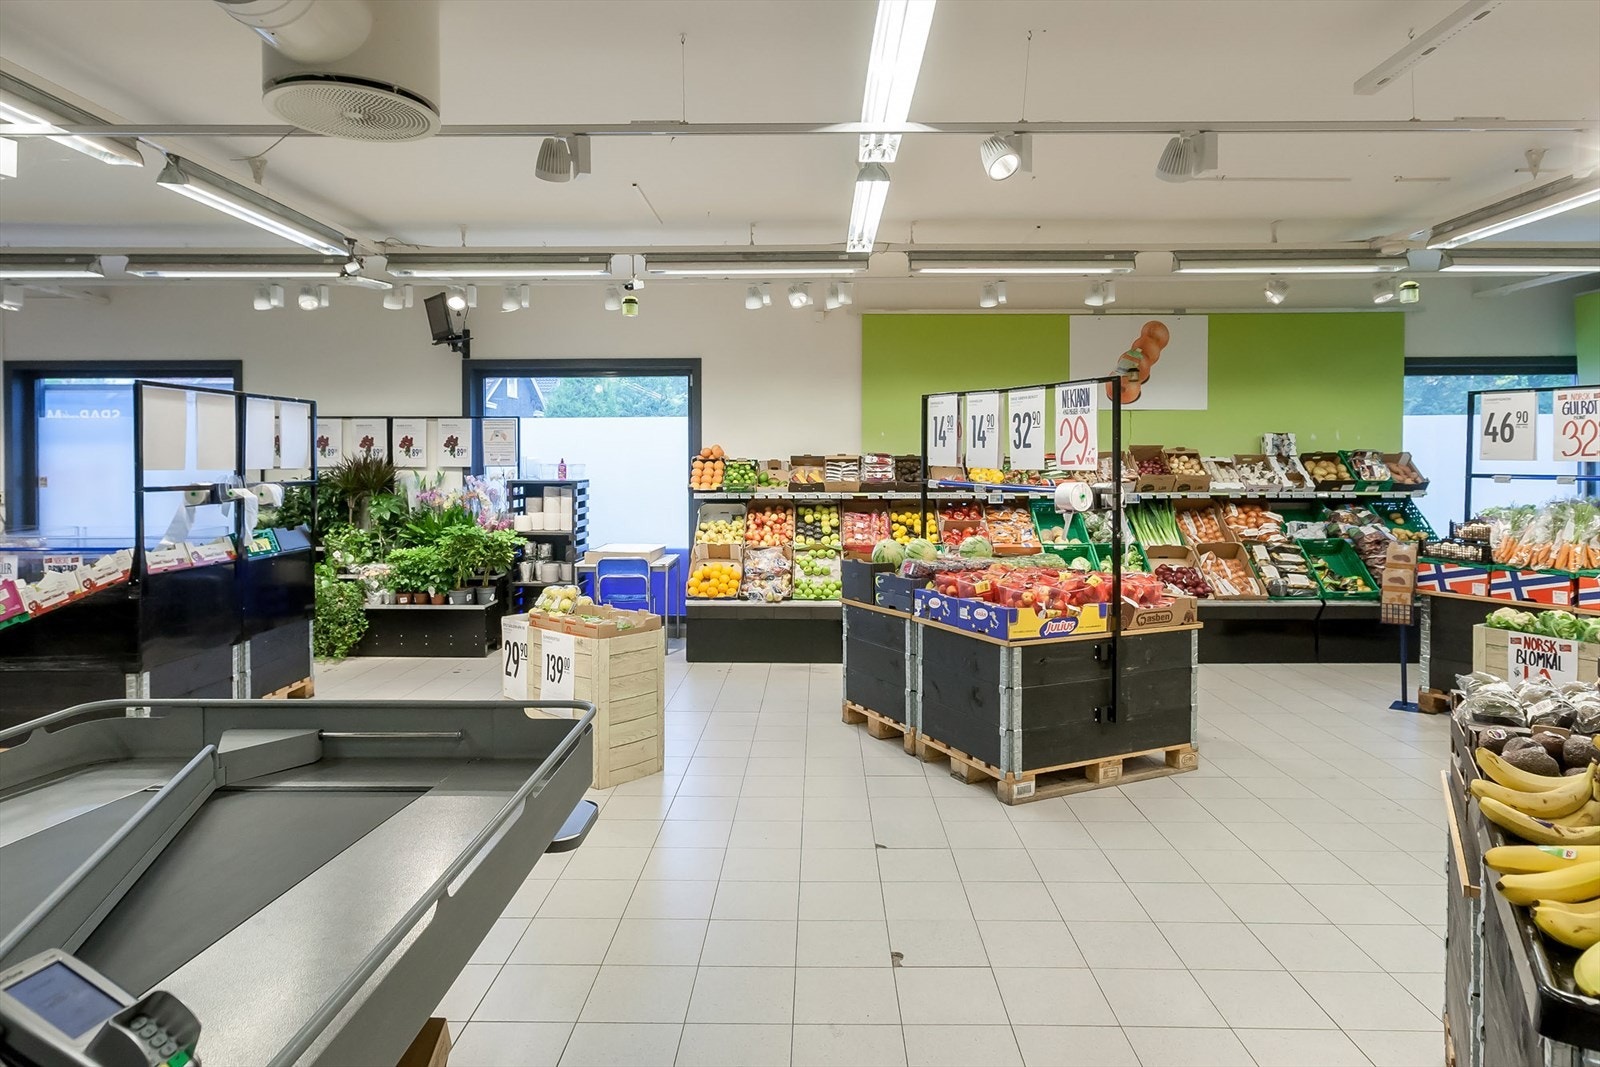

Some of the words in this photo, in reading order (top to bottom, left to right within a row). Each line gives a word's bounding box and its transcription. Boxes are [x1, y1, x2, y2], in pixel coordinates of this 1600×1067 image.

[1061, 387, 1090, 409] NEKTARIN
[1561, 400, 1599, 416] GULROT
[933, 415, 947, 448] 14
[946, 414, 954, 428] 90
[971, 414, 987, 449] 14
[986, 413, 995, 428] 90
[1012, 411, 1032, 450] 32
[1032, 410, 1041, 426] 90
[1483, 411, 1515, 443] 46
[1515, 410, 1529, 424] 90
[1561, 419, 1599, 457] 32
[504, 639, 520, 679] 29
[520, 642, 528, 658] 90
[1523, 635, 1558, 655] NORSK
[546, 653, 564, 684] 139
